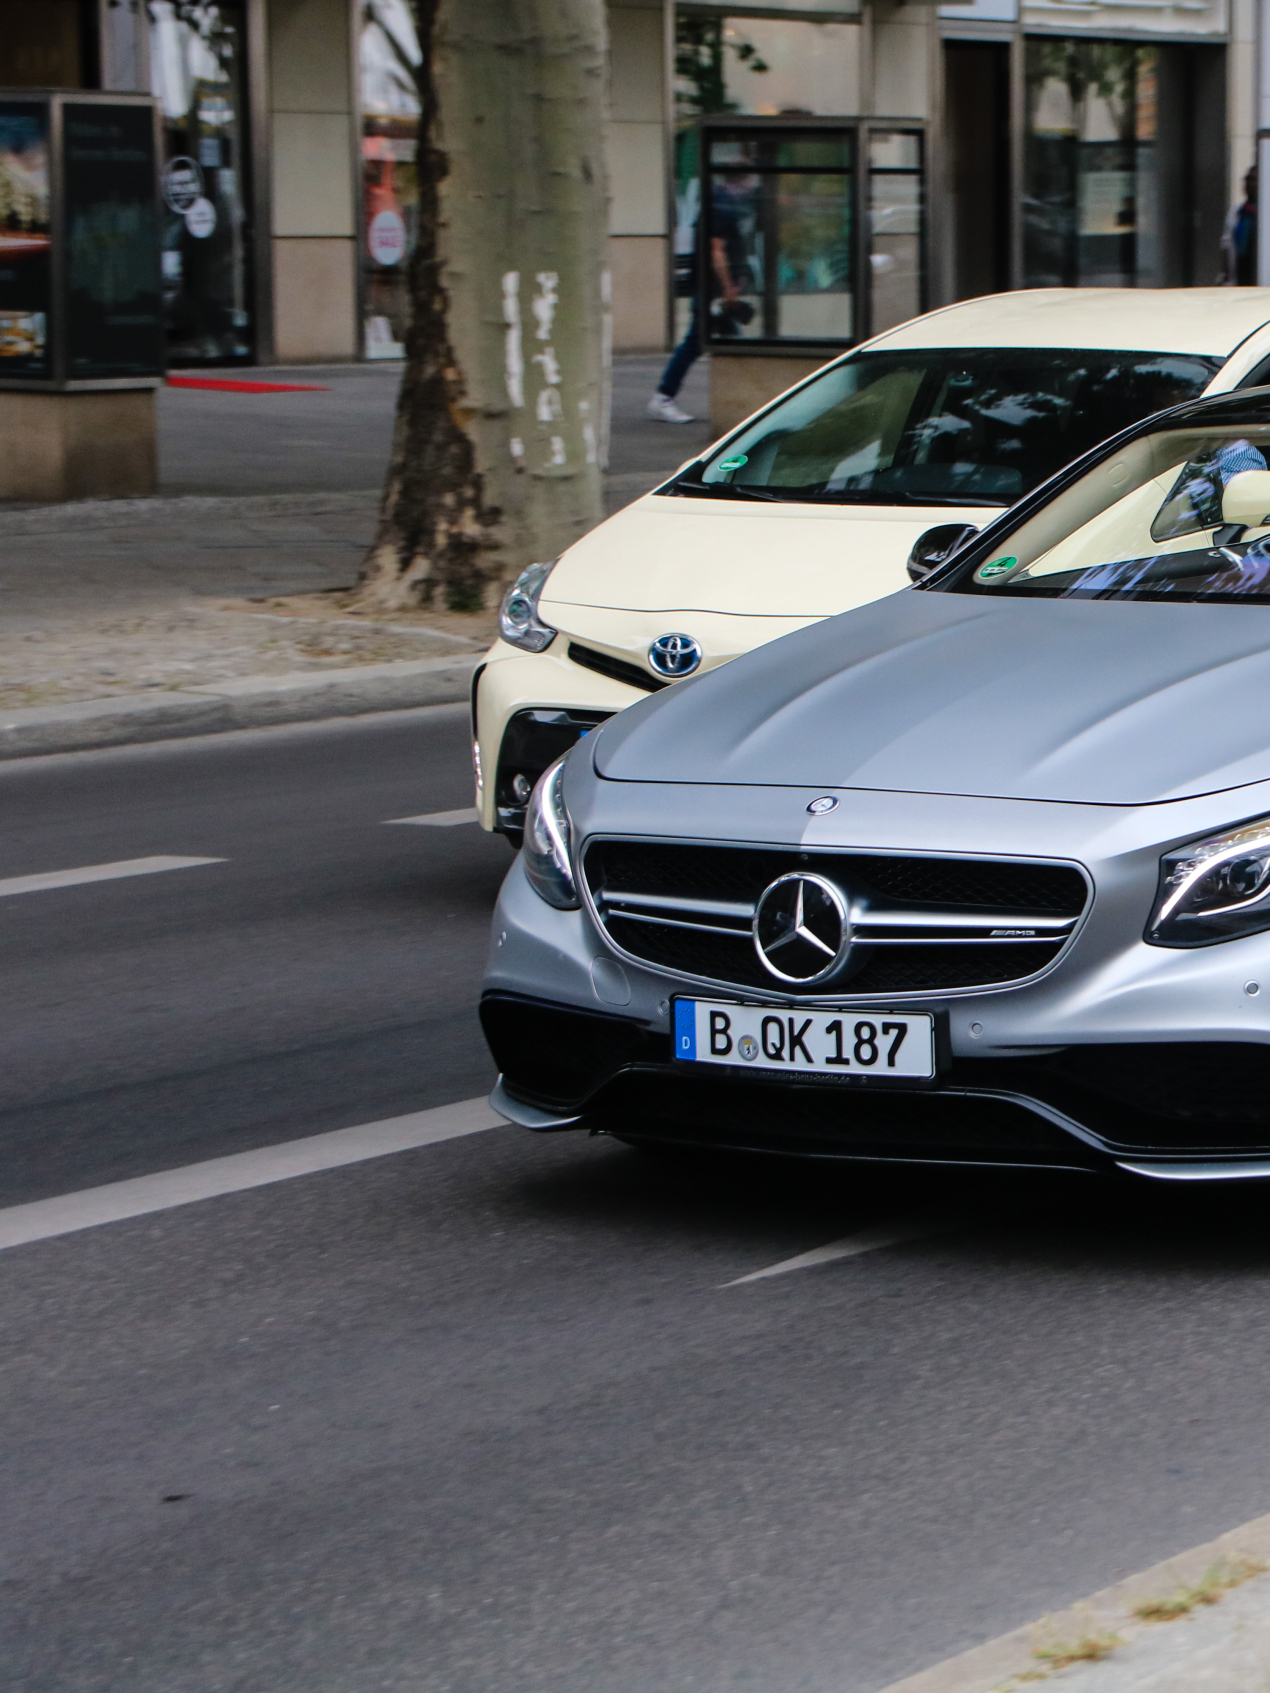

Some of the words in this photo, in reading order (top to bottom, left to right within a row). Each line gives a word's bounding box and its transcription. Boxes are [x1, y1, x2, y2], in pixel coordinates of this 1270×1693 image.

[1004, 929, 1036, 937] AMG
[682, 1036, 690, 1050] D
[709, 1010, 733, 1056] B
[760, 1015, 815, 1064] QK
[825, 1019, 908, 1068] 187
